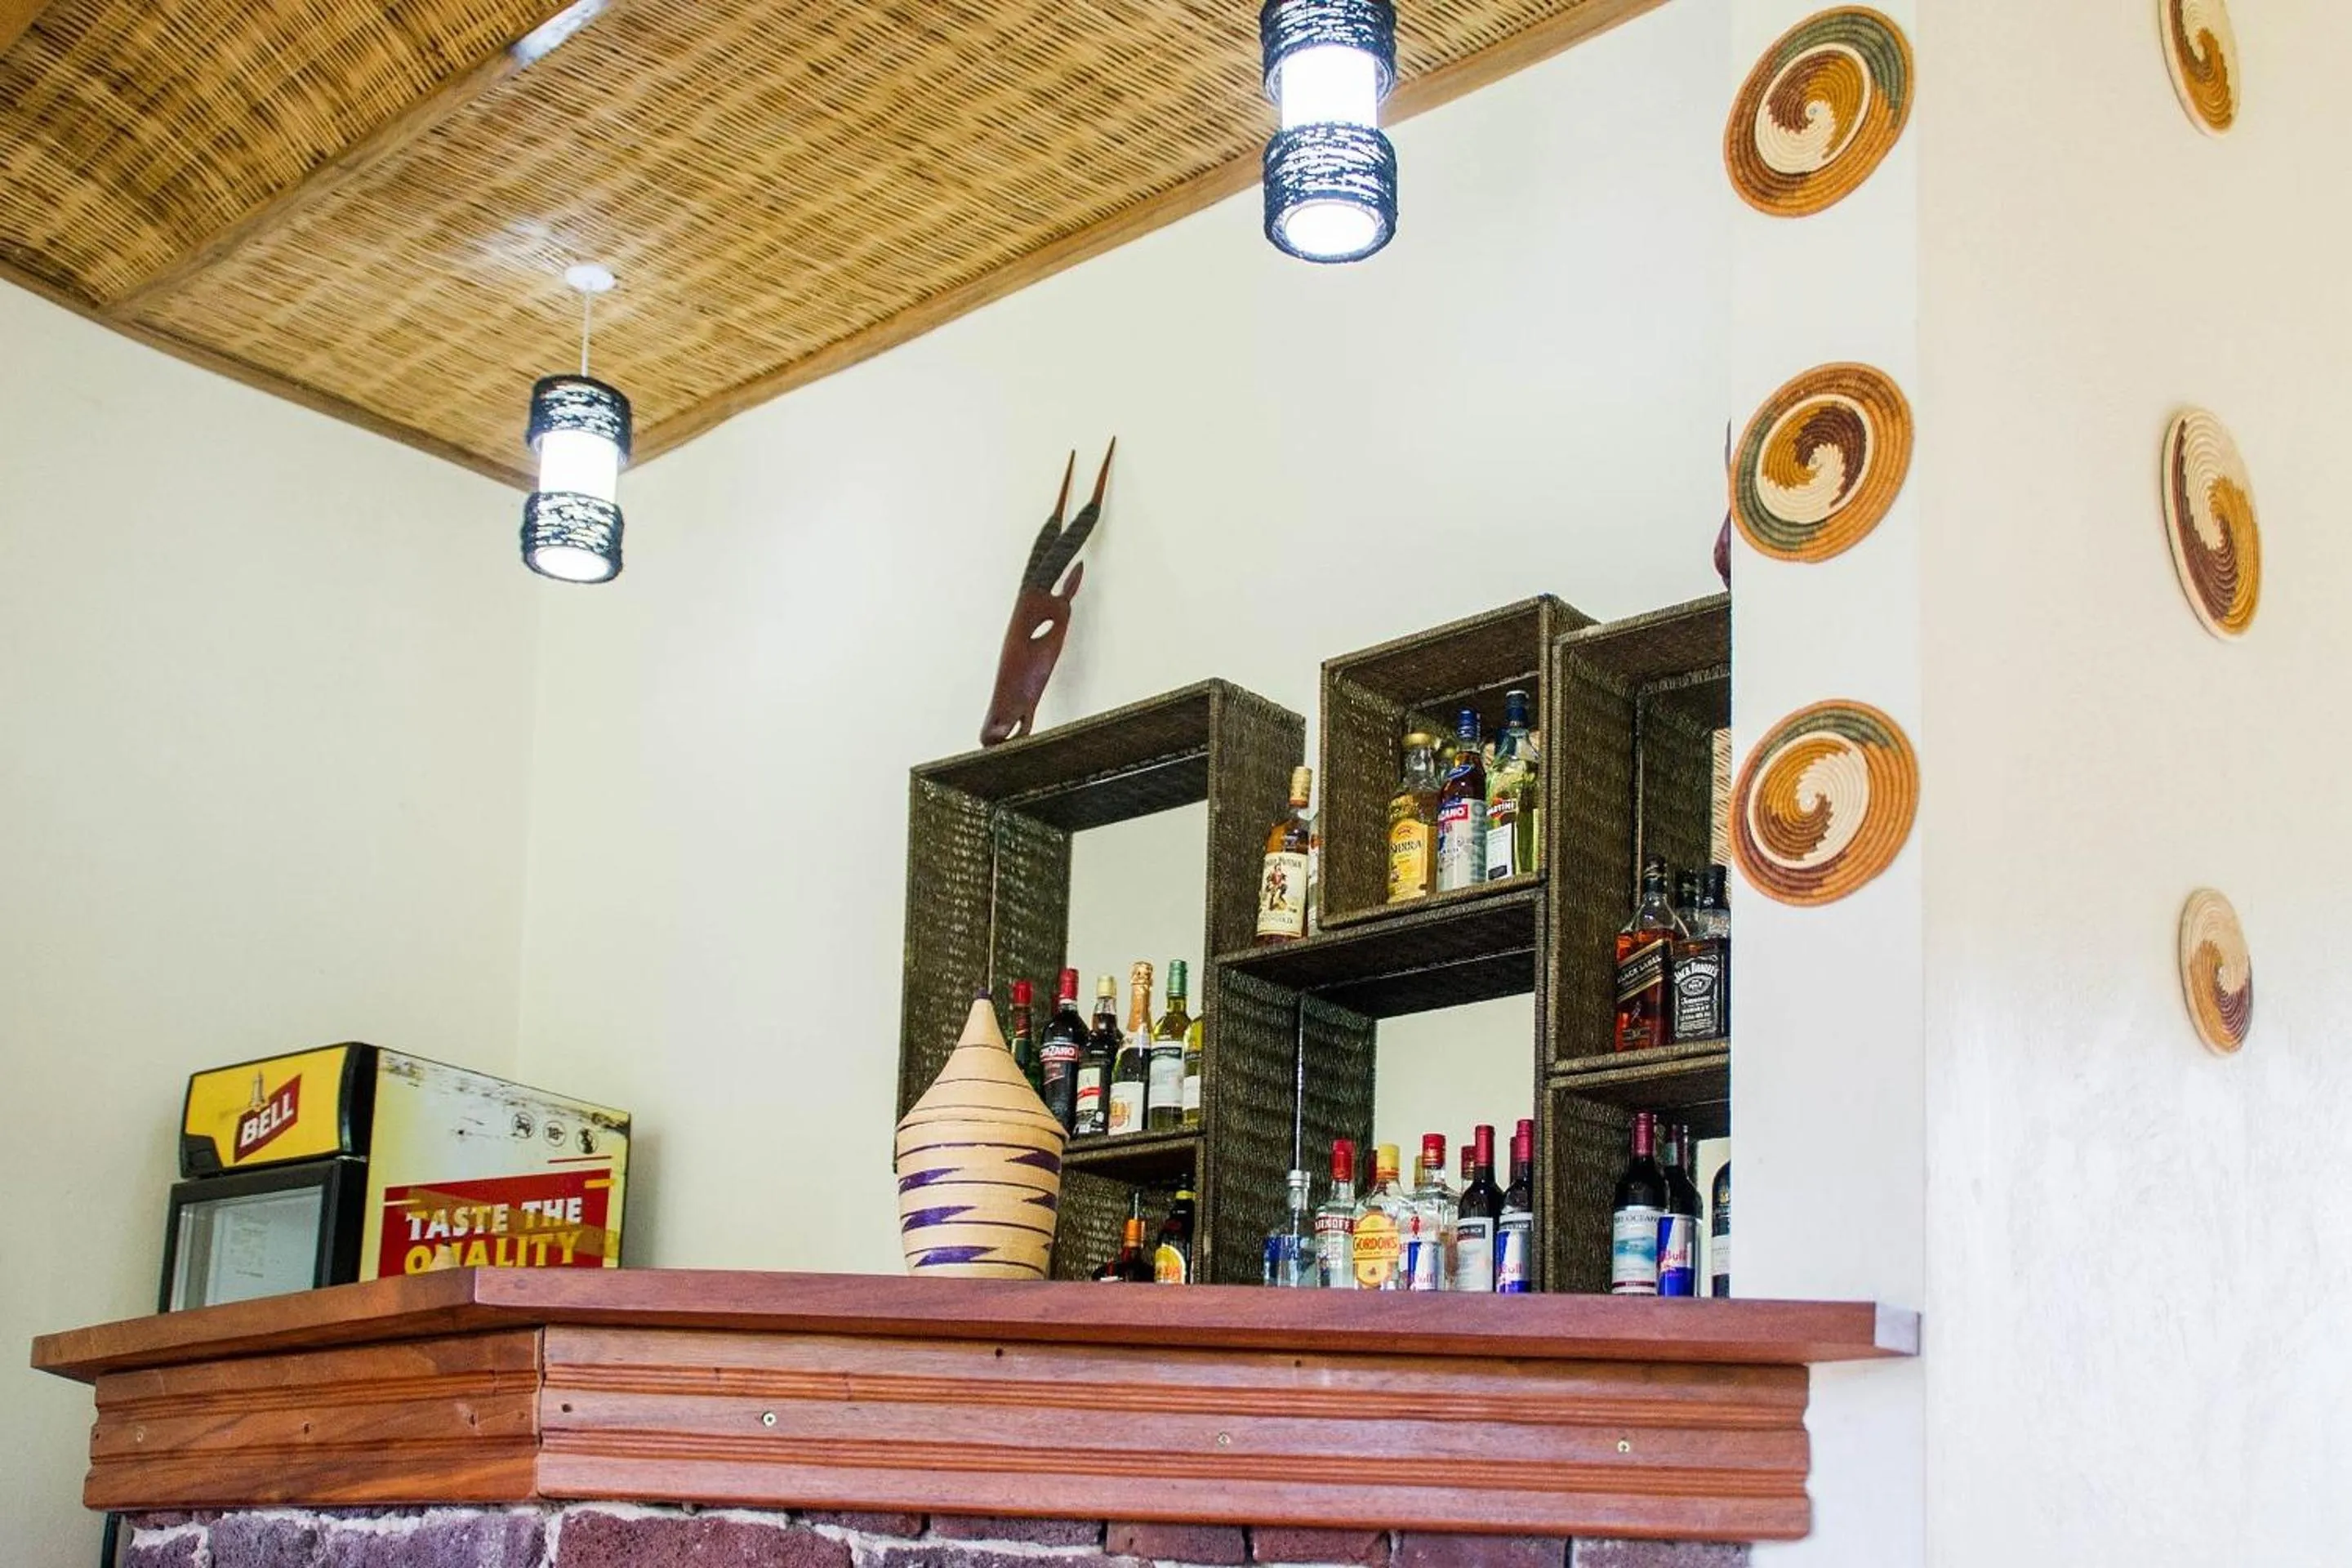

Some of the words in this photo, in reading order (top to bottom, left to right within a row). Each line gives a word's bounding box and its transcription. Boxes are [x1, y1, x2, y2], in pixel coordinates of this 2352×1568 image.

[239, 1092, 295, 1148] BELL
[406, 1203, 510, 1241] TASTE
[521, 1197, 582, 1229] THE
[404, 1230, 583, 1275] QALITY
